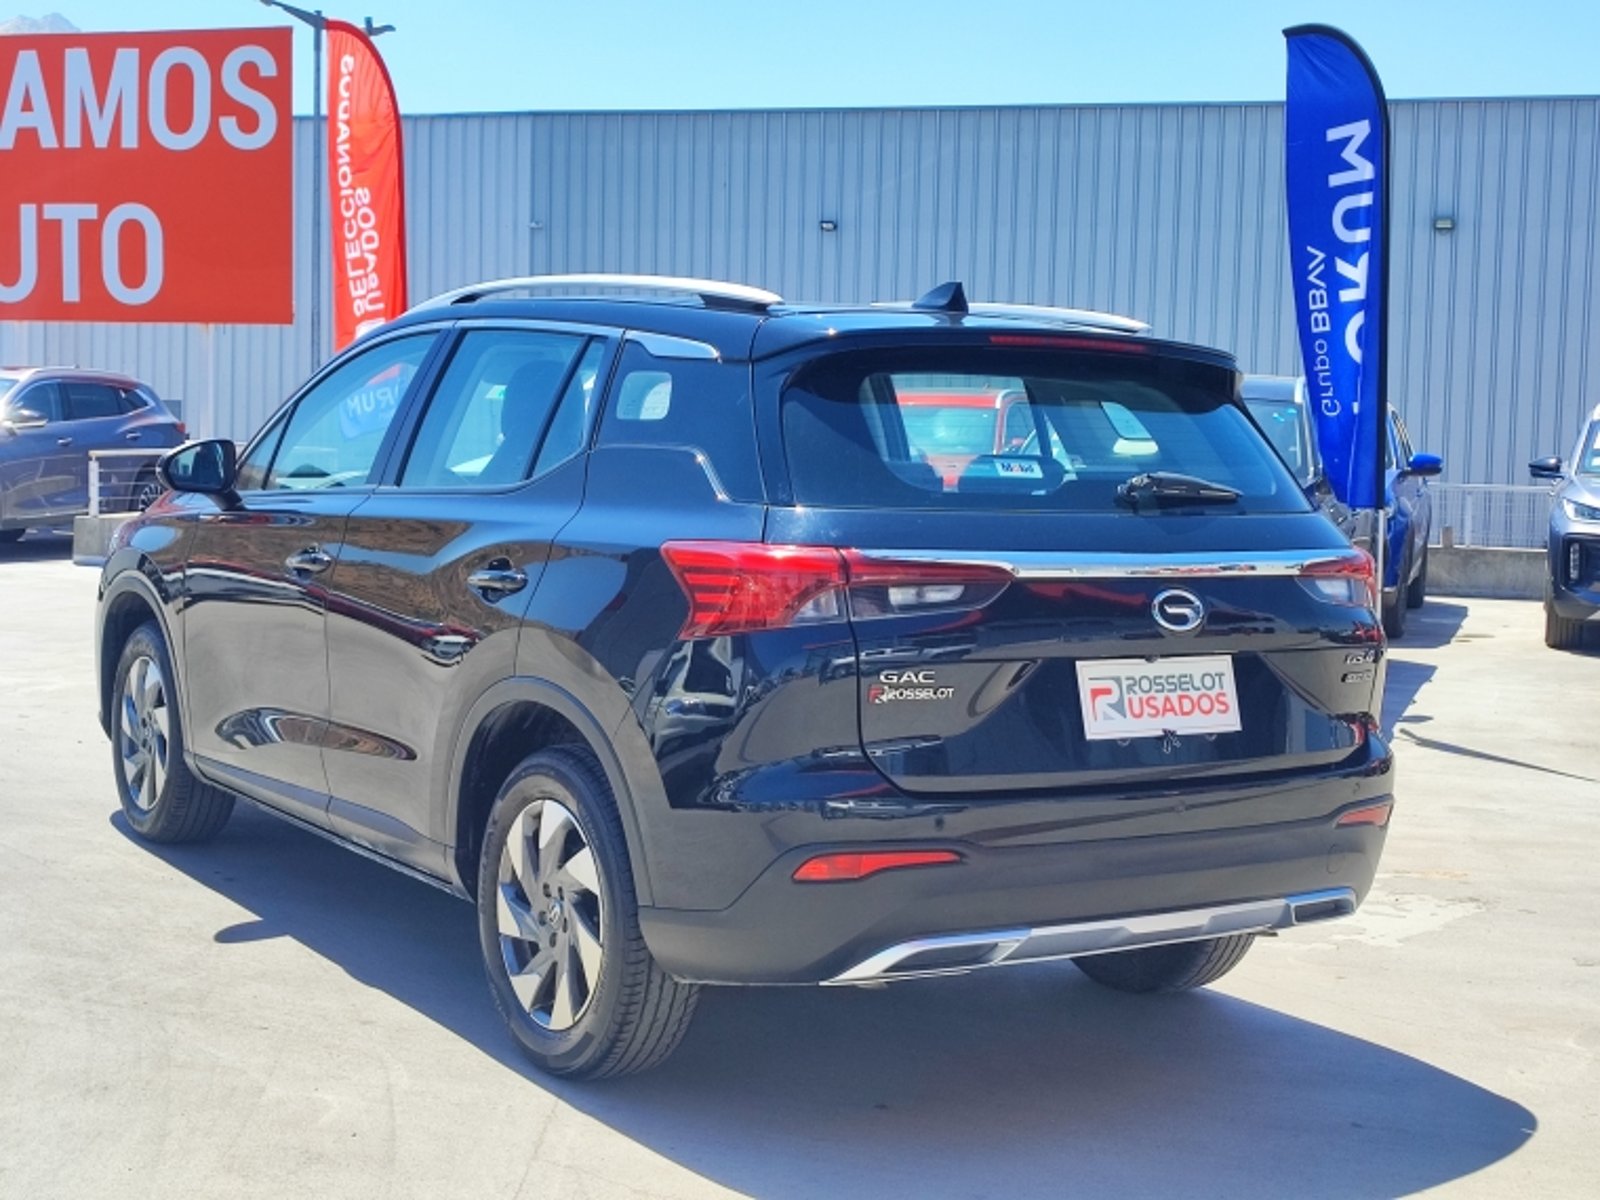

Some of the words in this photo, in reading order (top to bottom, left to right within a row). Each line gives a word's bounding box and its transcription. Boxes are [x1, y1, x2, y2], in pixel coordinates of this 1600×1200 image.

[0, 45, 278, 151] AMOS
[879, 670, 936, 684] GAC
[1125, 672, 1226, 695] ROSSELOT
[1127, 692, 1230, 719] USADOS
